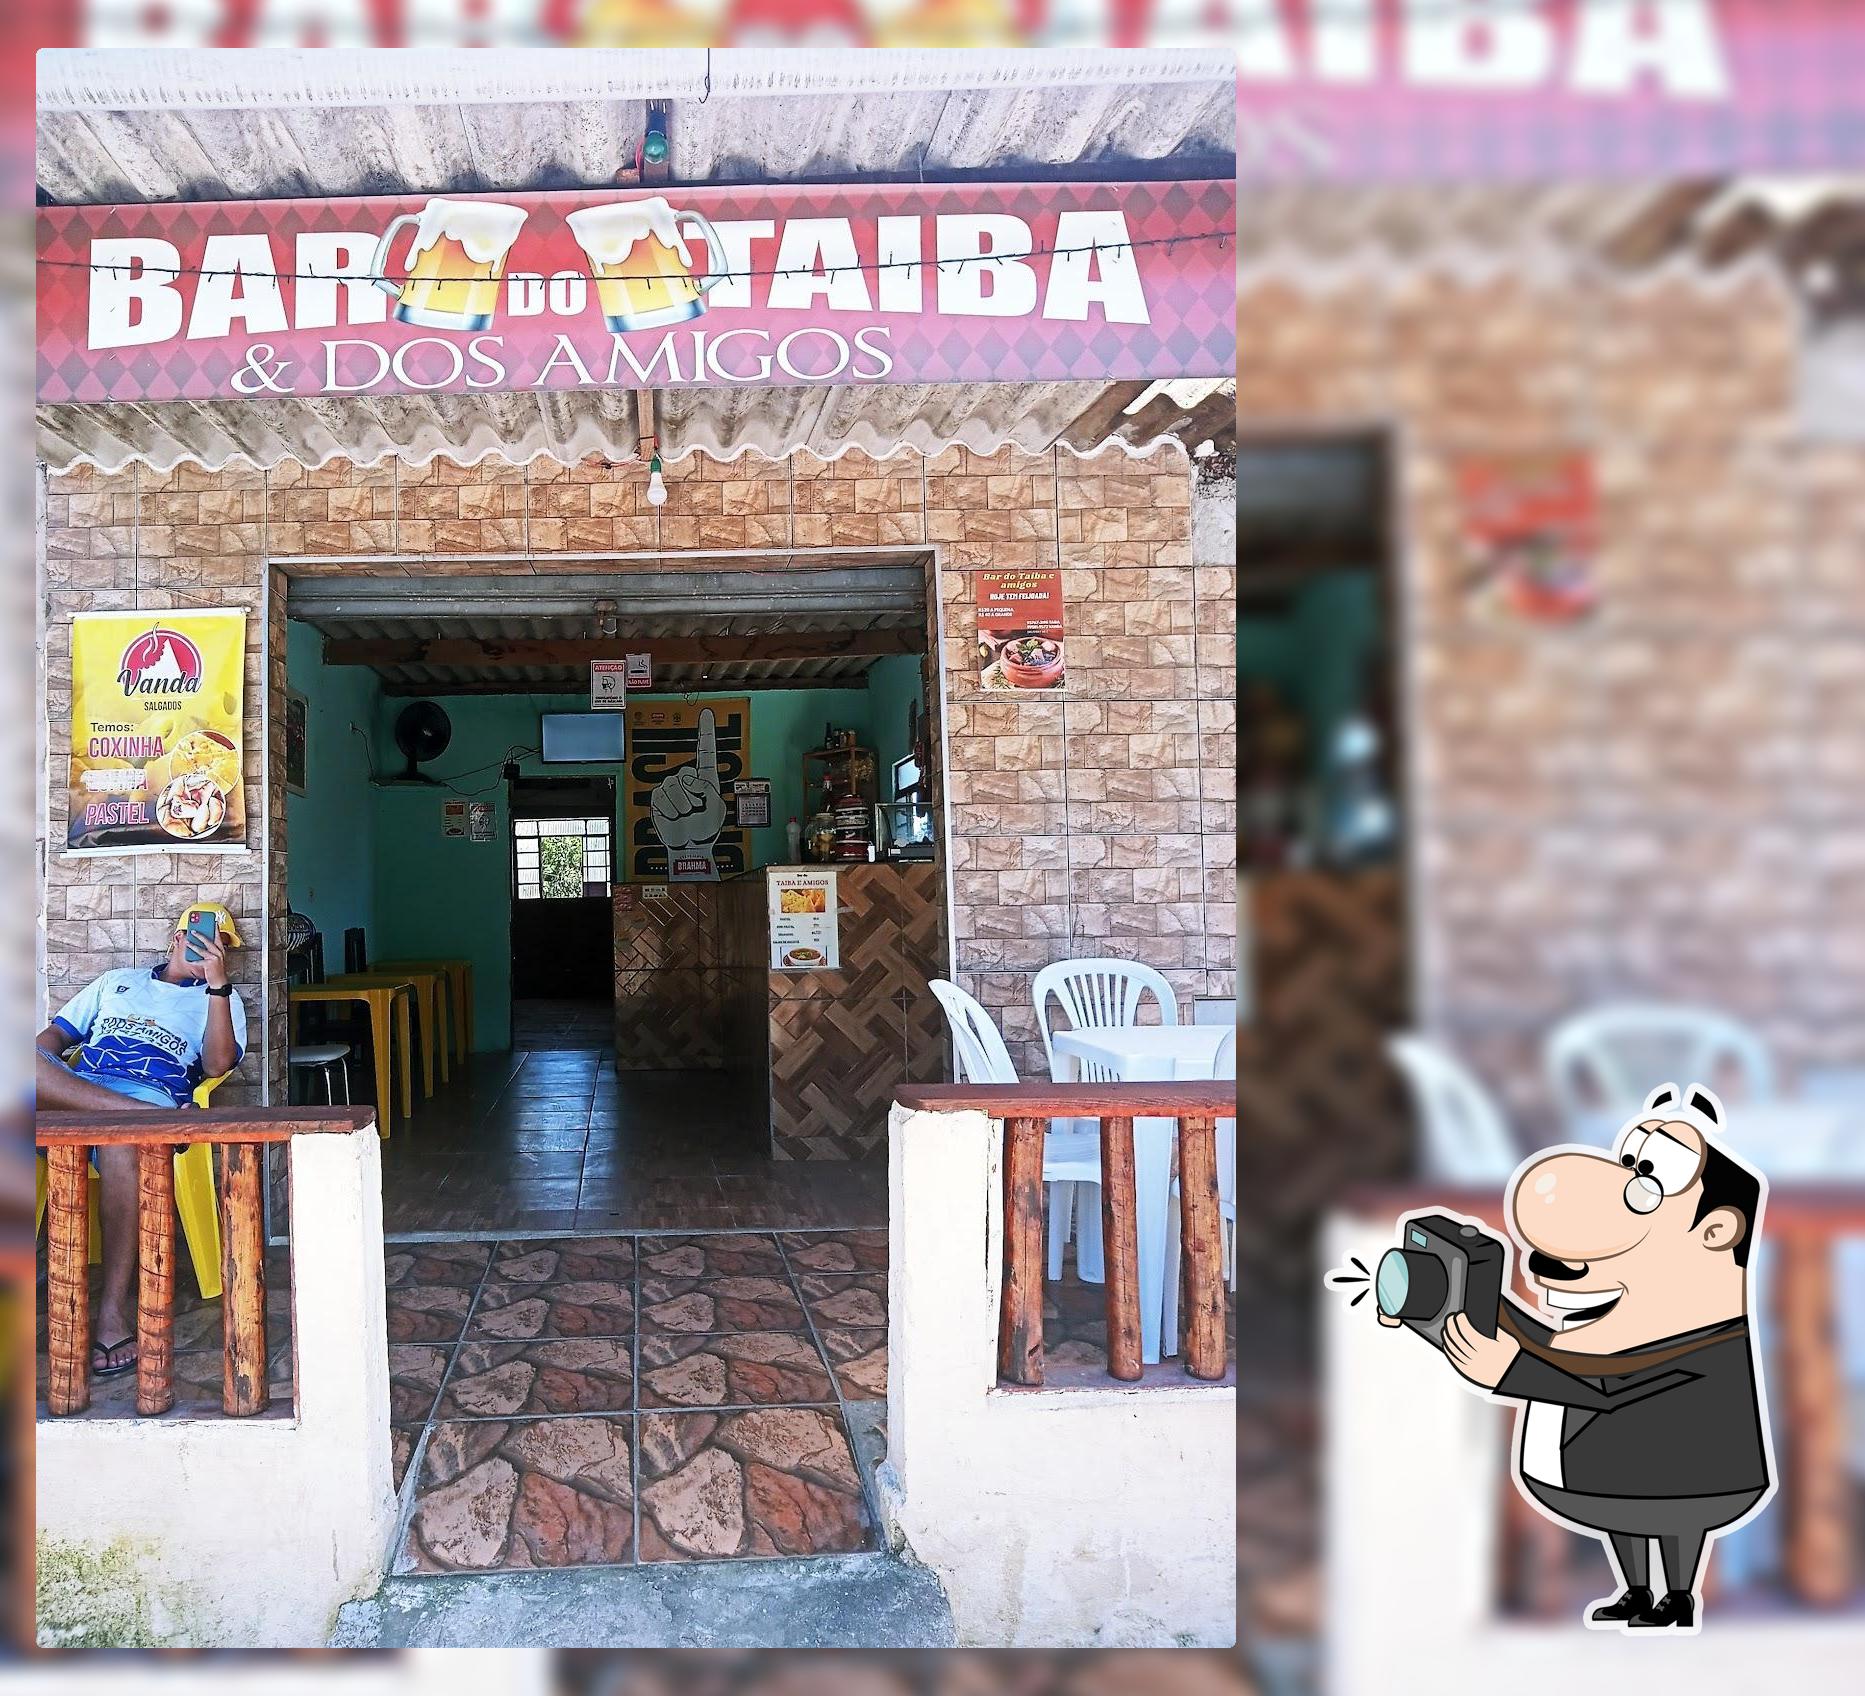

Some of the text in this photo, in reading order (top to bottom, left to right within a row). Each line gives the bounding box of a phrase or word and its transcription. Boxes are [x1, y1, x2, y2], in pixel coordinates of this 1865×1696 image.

[88, 210, 1151, 351] BAR DO TAIBA
[230, 326, 894, 393] & DOS AMIGOS
[983, 573, 1002, 581] Bar
[1003, 572, 1016, 580] do
[1019, 572, 1047, 580] Taiba
[1000, 581, 1038, 590] amigos
[1019, 592, 1050, 600] FEIJOADA!
[117, 669, 201, 697] Vanda
[144, 701, 182, 711] SALGADOS
[90, 722, 134, 733] Temos:
[89, 736, 164, 757] COXINHA
[84, 803, 150, 826] PASTEL
[677, 860, 707, 871] BRAHMA
